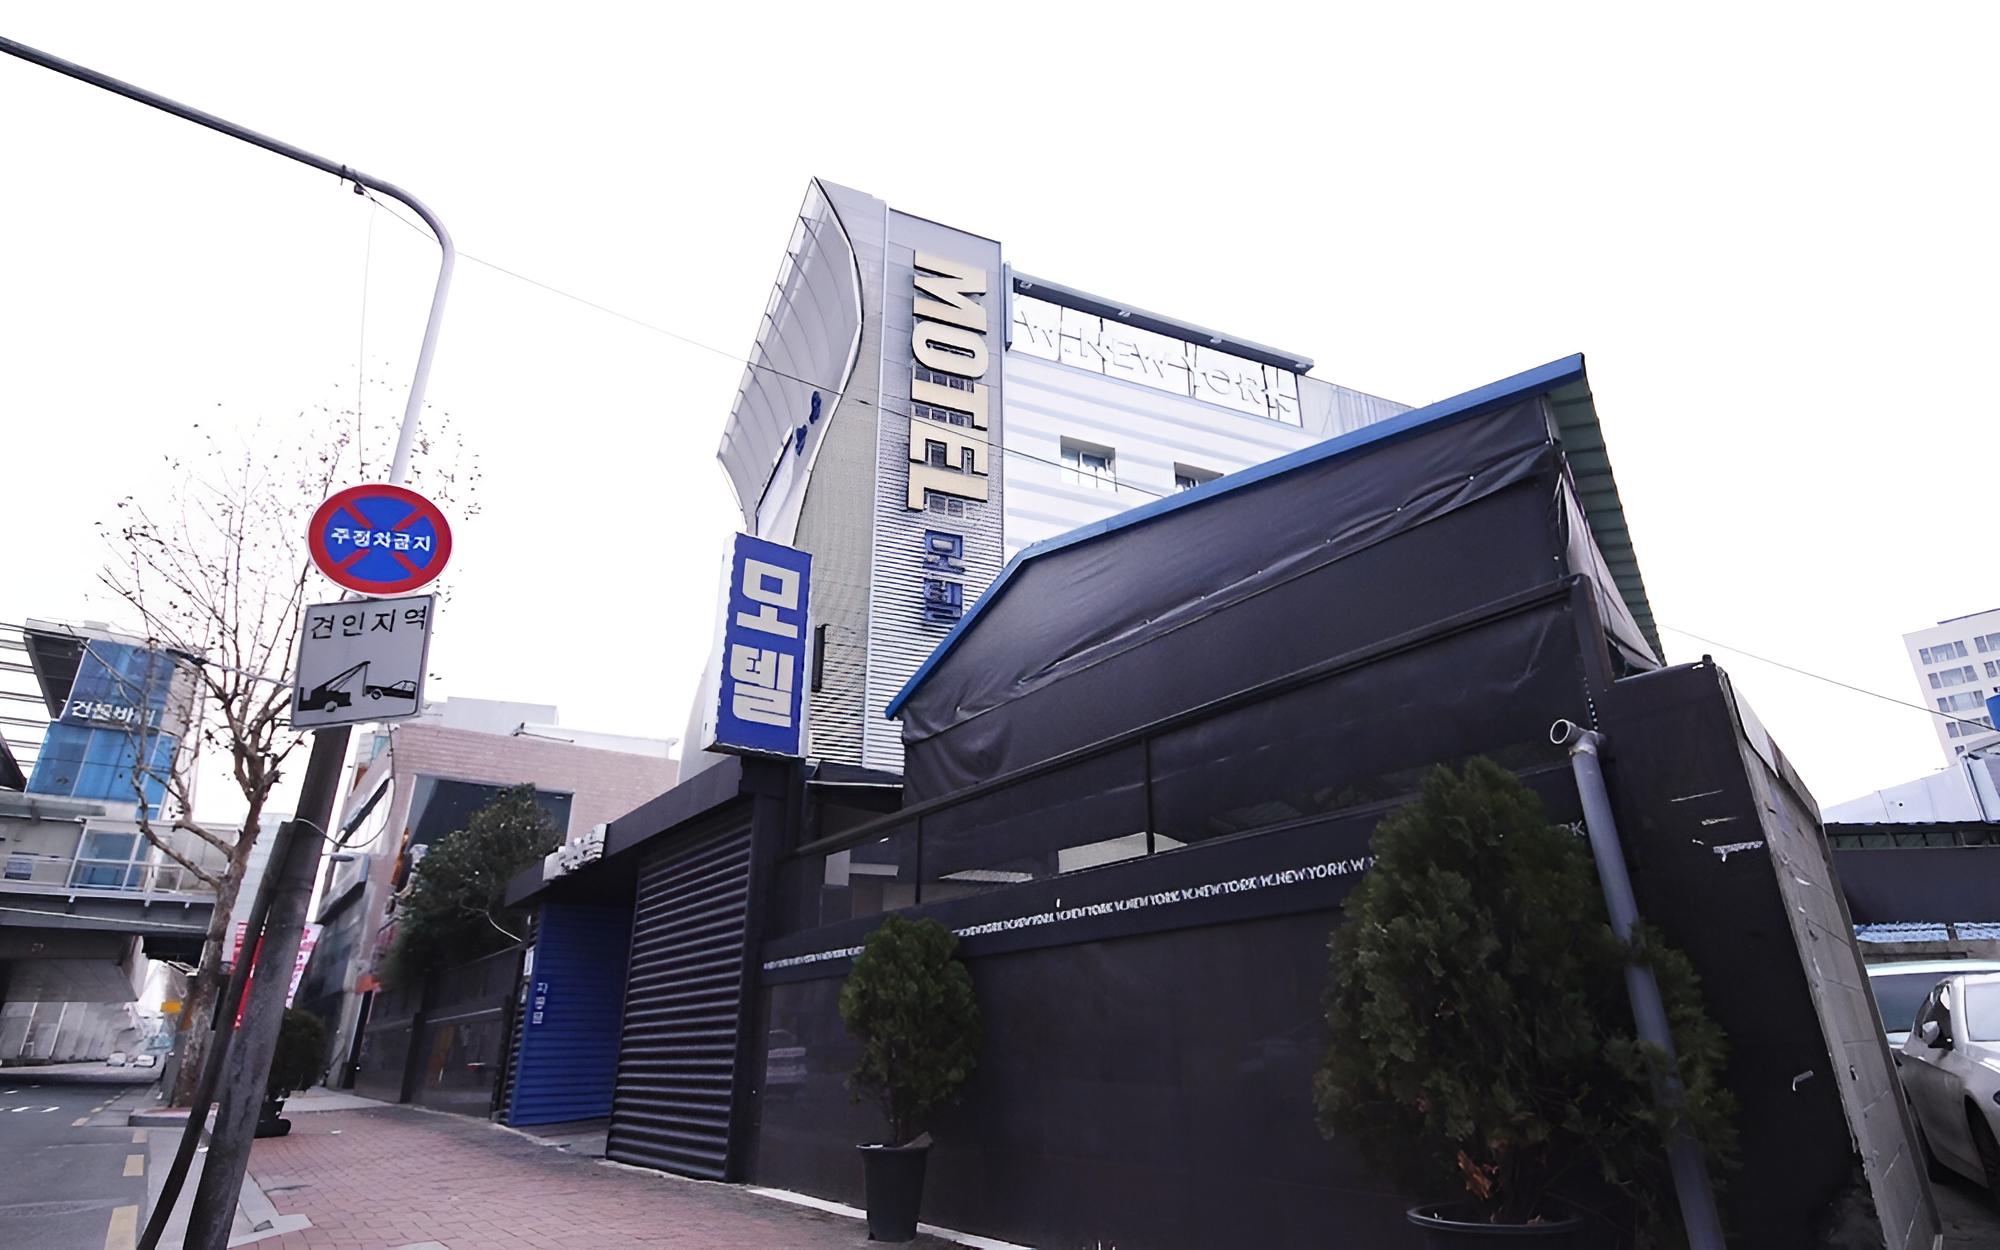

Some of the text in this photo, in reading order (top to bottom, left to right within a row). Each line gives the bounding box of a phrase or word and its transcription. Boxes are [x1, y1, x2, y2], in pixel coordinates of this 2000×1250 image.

[906, 249, 989, 512] MOTEL
[330, 526, 431, 553] 주정차금지
[310, 604, 427, 641] 견인지역
[729, 557, 801, 729] 모텔
